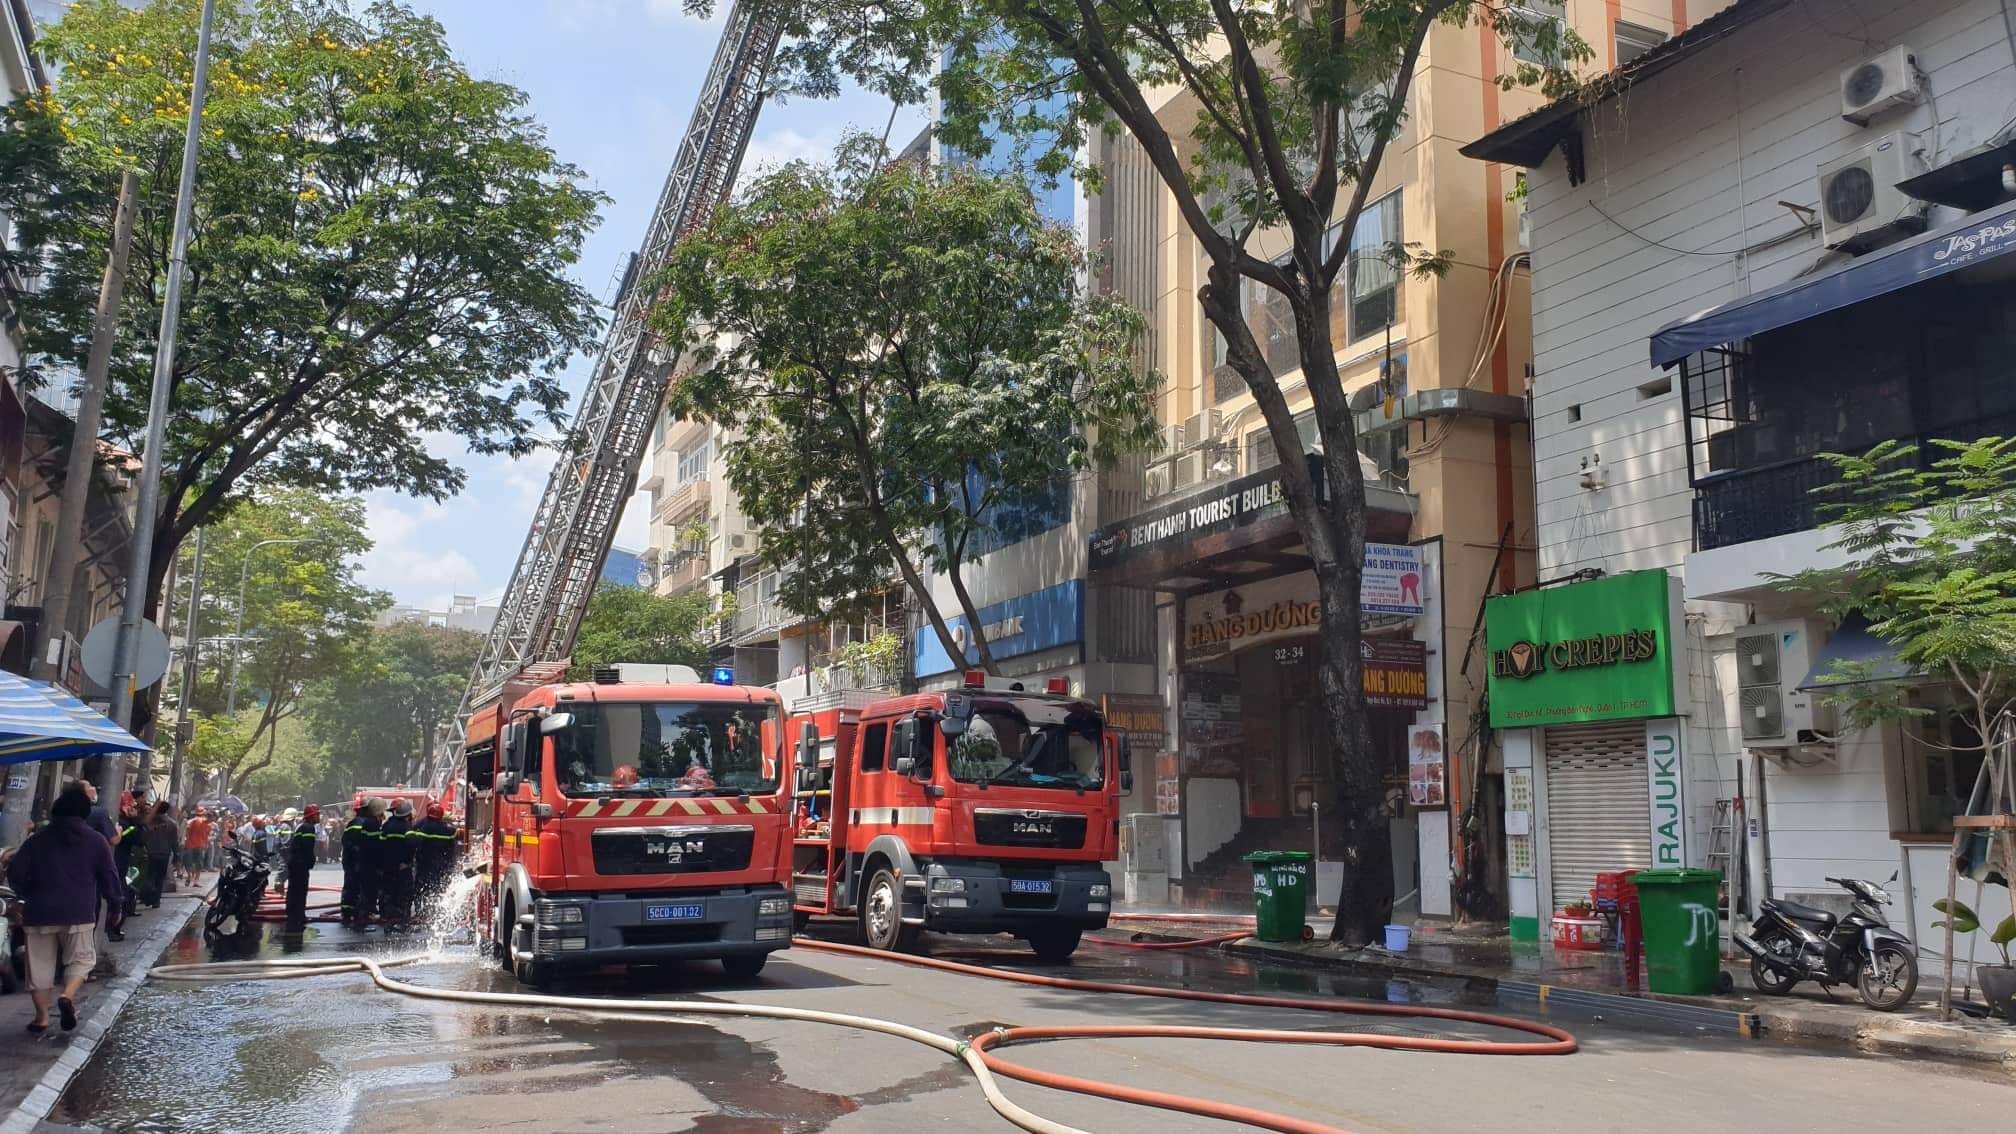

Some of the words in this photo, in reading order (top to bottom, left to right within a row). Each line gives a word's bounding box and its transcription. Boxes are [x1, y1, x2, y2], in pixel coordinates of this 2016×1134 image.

[1979, 244, 2004, 255] GRILL
[1130, 511, 1186, 548] BENTHANH
[1188, 492, 1239, 530] TOURIST
[1379, 560, 1419, 572] DENTISTRY
[1550, 629, 1656, 671] CREPES
[1652, 734, 1680, 864] RAJUKU
[1013, 822, 1052, 833] MAN
[647, 841, 704, 854] MAN
